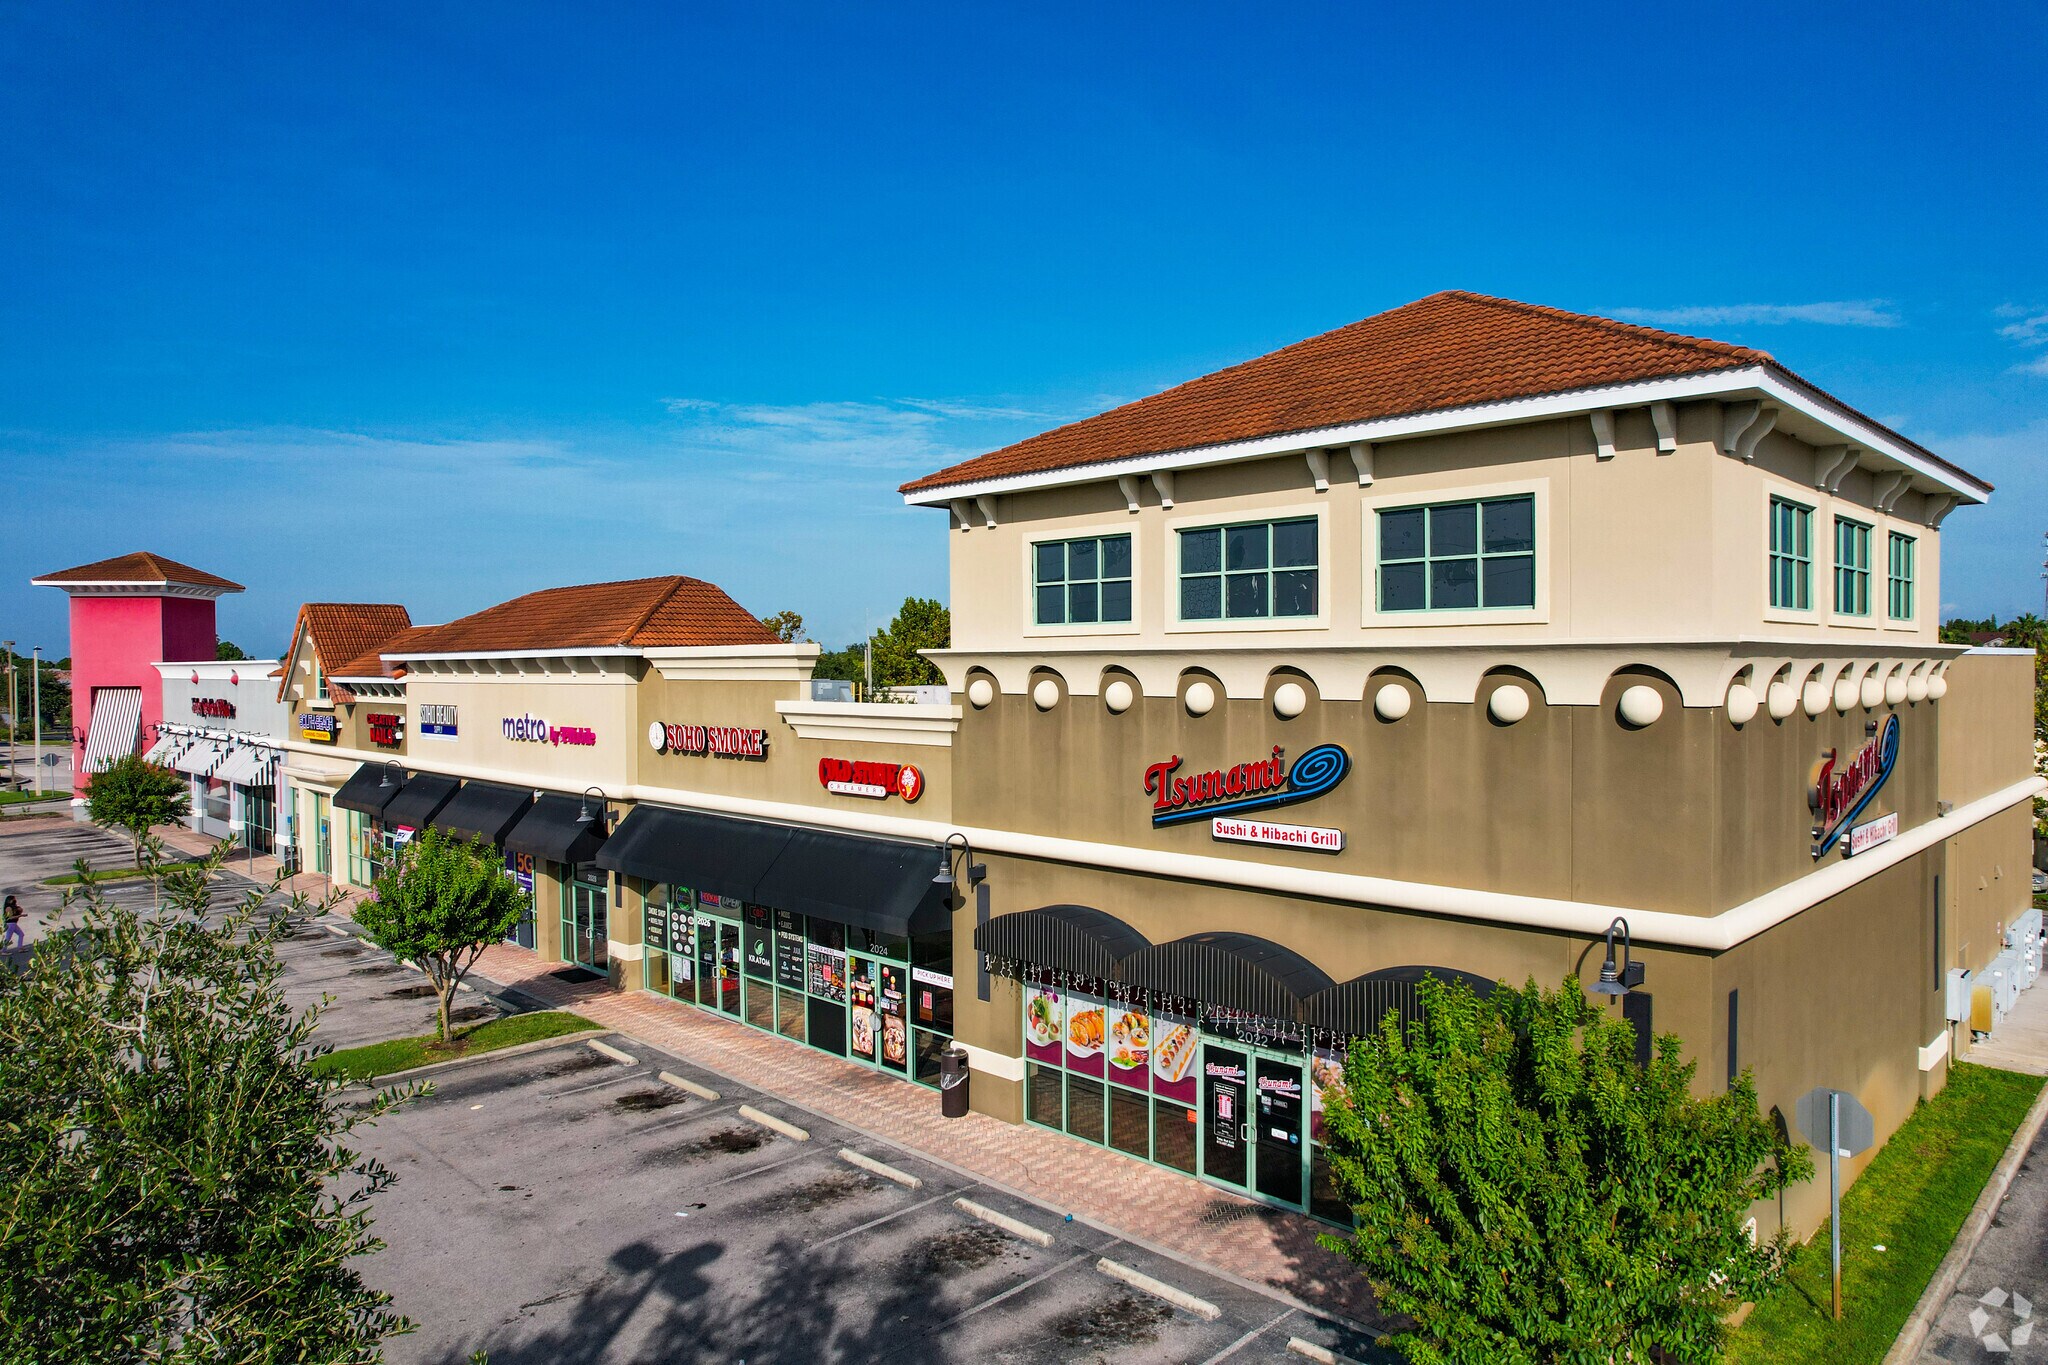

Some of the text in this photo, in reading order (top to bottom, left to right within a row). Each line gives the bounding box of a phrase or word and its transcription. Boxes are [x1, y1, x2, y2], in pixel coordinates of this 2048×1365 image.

[316, 714, 334, 732] BEACH
[366, 713, 397, 727] CREATIVE
[420, 704, 458, 726] SOHO BEAUTY
[502, 712, 546, 741] metro
[369, 727, 393, 744] NAILS
[666, 723, 763, 756] SOHO SMOKE
[1144, 744, 1285, 809] Tsunami
[829, 783, 884, 795] CREAMERY
[1215, 821, 1338, 847] Sushi & Hibachi Grill
[517, 851, 533, 874] 5G
[697, 916, 711, 927] 2026
[869, 943, 889, 956] 2024
[748, 953, 771, 967] KRATOM
[917, 969, 929, 979] PICK
[936, 975, 951, 984] HERE
[1237, 1029, 1269, 1048] 2022
[1206, 1063, 1239, 1076] Tsunami
[1258, 1076, 1294, 1090] Tsunami
